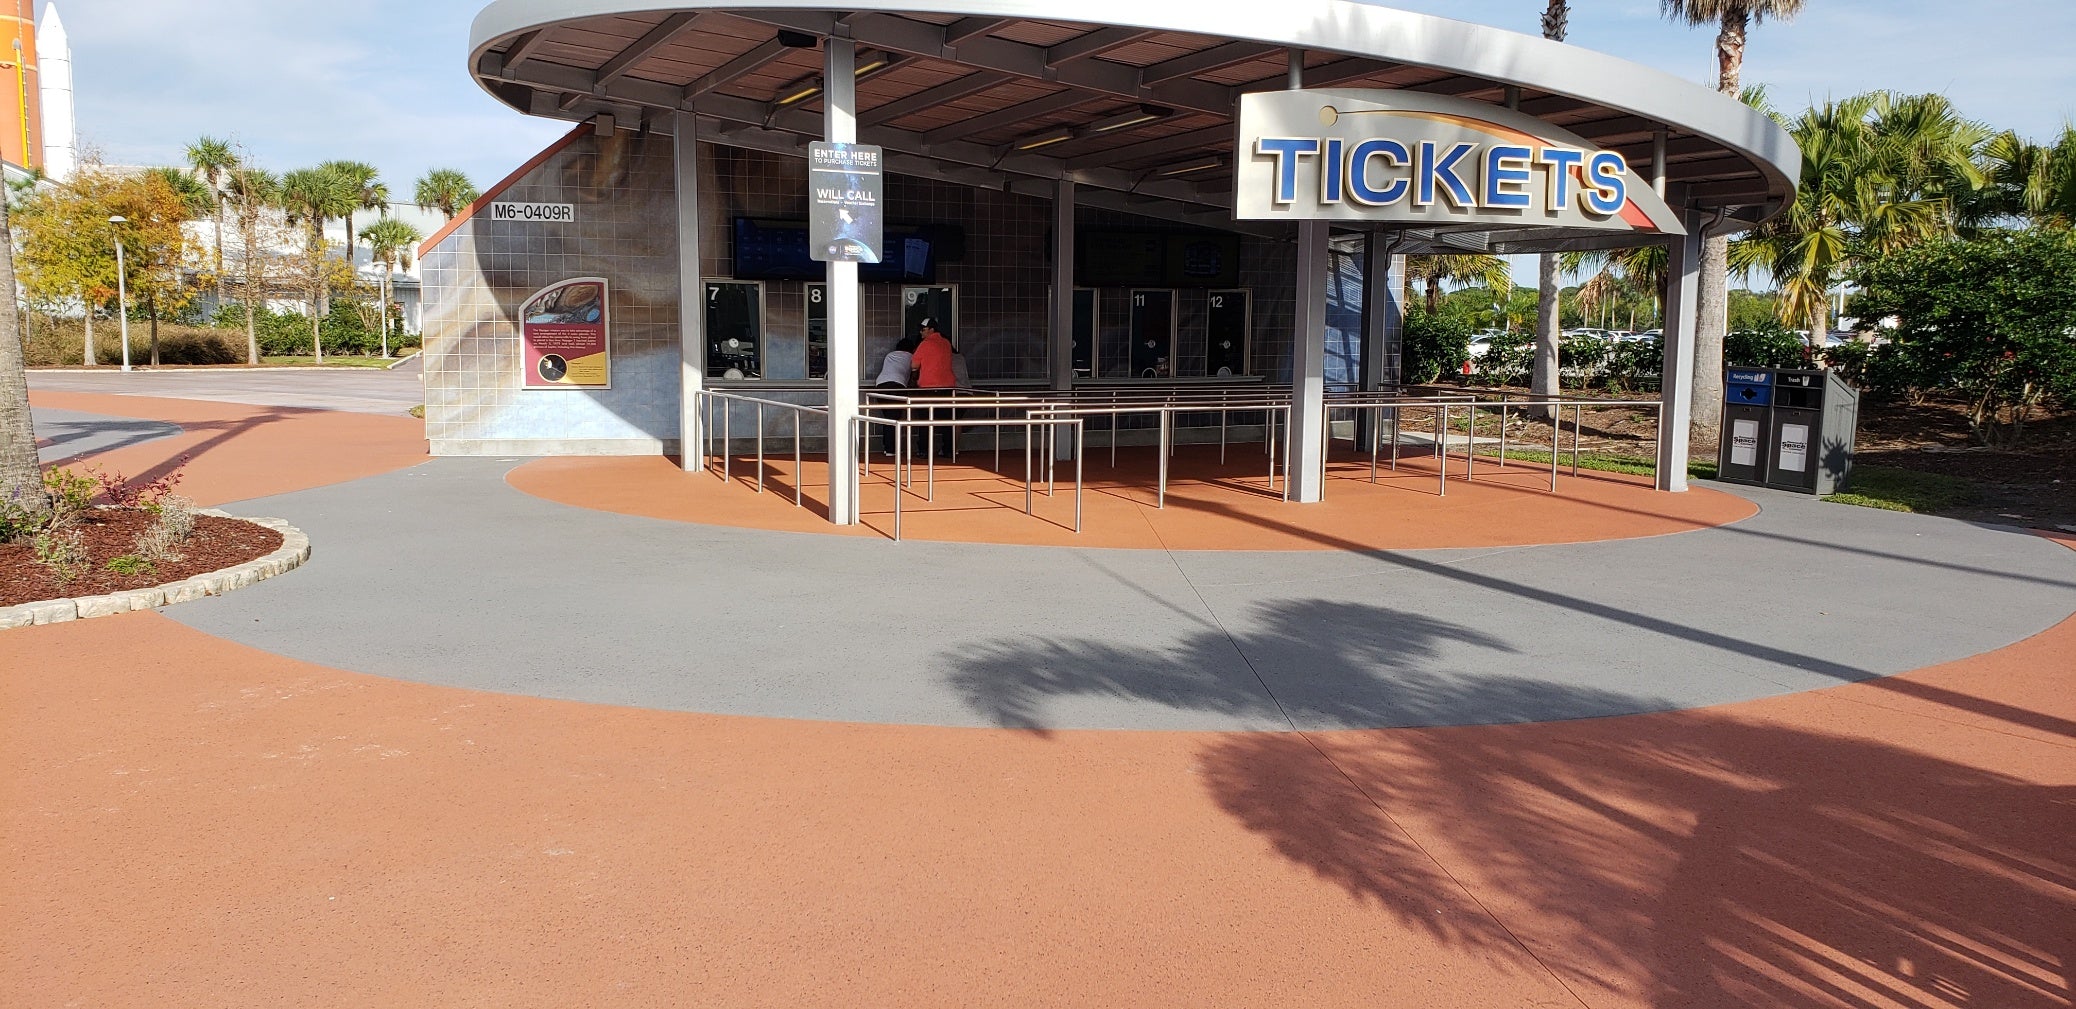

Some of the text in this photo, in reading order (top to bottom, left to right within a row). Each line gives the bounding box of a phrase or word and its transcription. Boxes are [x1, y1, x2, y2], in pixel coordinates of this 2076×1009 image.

[814, 149, 877, 161] ENTER HERE
[1257, 136, 1627, 215] TICKETS
[817, 188, 875, 202] WILL CALL
[495, 204, 571, 220] M6-0409R
[709, 287, 719, 301] 7
[811, 289, 821, 303] 8
[908, 291, 917, 306] 9
[1134, 294, 1145, 307] 11
[1210, 296, 1223, 308] 12
